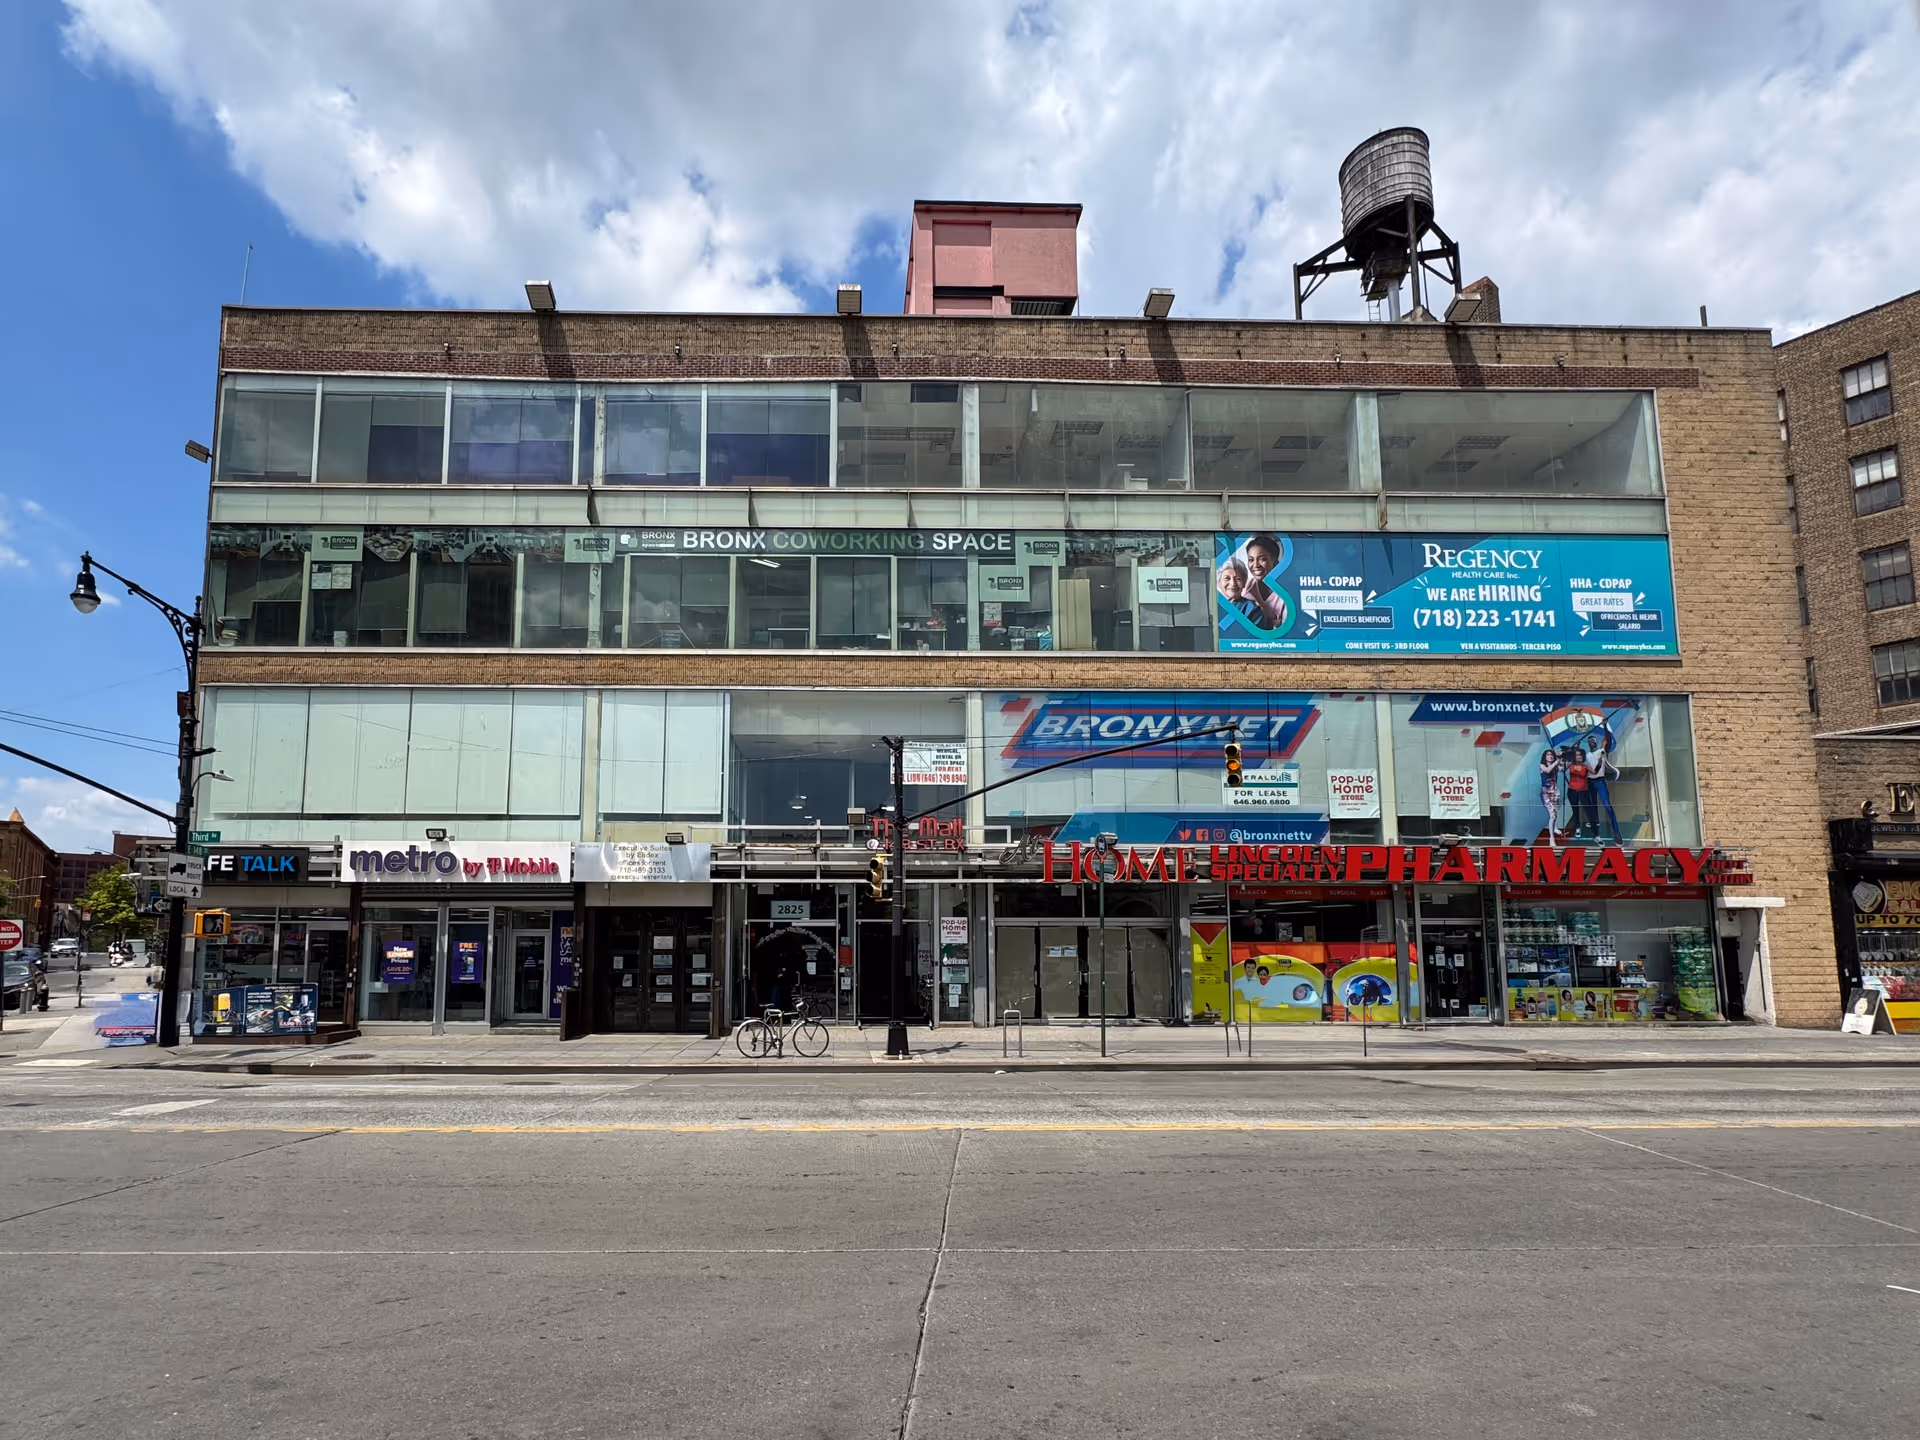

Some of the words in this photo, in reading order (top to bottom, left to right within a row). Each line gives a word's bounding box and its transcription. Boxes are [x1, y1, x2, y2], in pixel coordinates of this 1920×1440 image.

[642, 531, 676, 540] BRONX
[683, 531, 766, 549] BRONX
[772, 532, 924, 550] COWORKING
[932, 533, 1012, 550] SPACE
[1034, 541, 1059, 549] BRONX
[1422, 543, 1543, 569] REGENCY
[1451, 571, 1482, 579] HEALTH
[1483, 571, 1505, 579] CARE
[1300, 576, 1322, 587] HHA
[1329, 576, 1362, 587] CDPAP
[1569, 578, 1592, 588] HHA
[1599, 578, 1633, 589] CDPAP
[1426, 588, 1448, 601] WE
[1450, 588, 1477, 601] ARE
[1478, 584, 1542, 602] HIRING
[1305, 595, 1325, 604] GREAT
[1327, 595, 1359, 604] BENEFITS
[1580, 597, 1601, 606] GREAT
[1603, 597, 1624, 606] RATES
[1323, 615, 1357, 624] EXCELENTES
[1358, 615, 1391, 624] BENEFICIOS
[1413, 608, 1462, 629] (718)
[1466, 609, 1500, 627] 223
[1618, 622, 1641, 630] SALARIO
[1345, 642, 1364, 650] COME
[1365, 642, 1380, 650] VISIT
[1460, 642, 1474, 650] VEN
[1546, 643, 1562, 651] PISO
[1431, 701, 1553, 713] www.bronxnet.tv
[1032, 715, 1298, 738] BRONXNET
[1885, 782, 1920, 815] E
[919, 816, 963, 836] Mall
[1871, 824, 1907, 832] JEWELRY
[192, 832, 209, 842] Third
[1229, 828, 1312, 841] @bronxnettv
[916, 839, 936, 850] ST
[944, 839, 965, 850] BX
[1210, 845, 1342, 863] LINCOLN
[240, 855, 295, 872] TALK
[350, 845, 458, 874] metro
[462, 858, 483, 878] by
[503, 857, 560, 875] Mobile
[1042, 841, 1200, 884] HOME
[1345, 846, 1714, 884] PHARMACY
[1211, 863, 1342, 881] SPECIALTY
[169, 885, 188, 893] LOCAL
[777, 905, 804, 914] 2825
[1857, 914, 1877, 925] UP
[1880, 914, 1900, 925] TO
